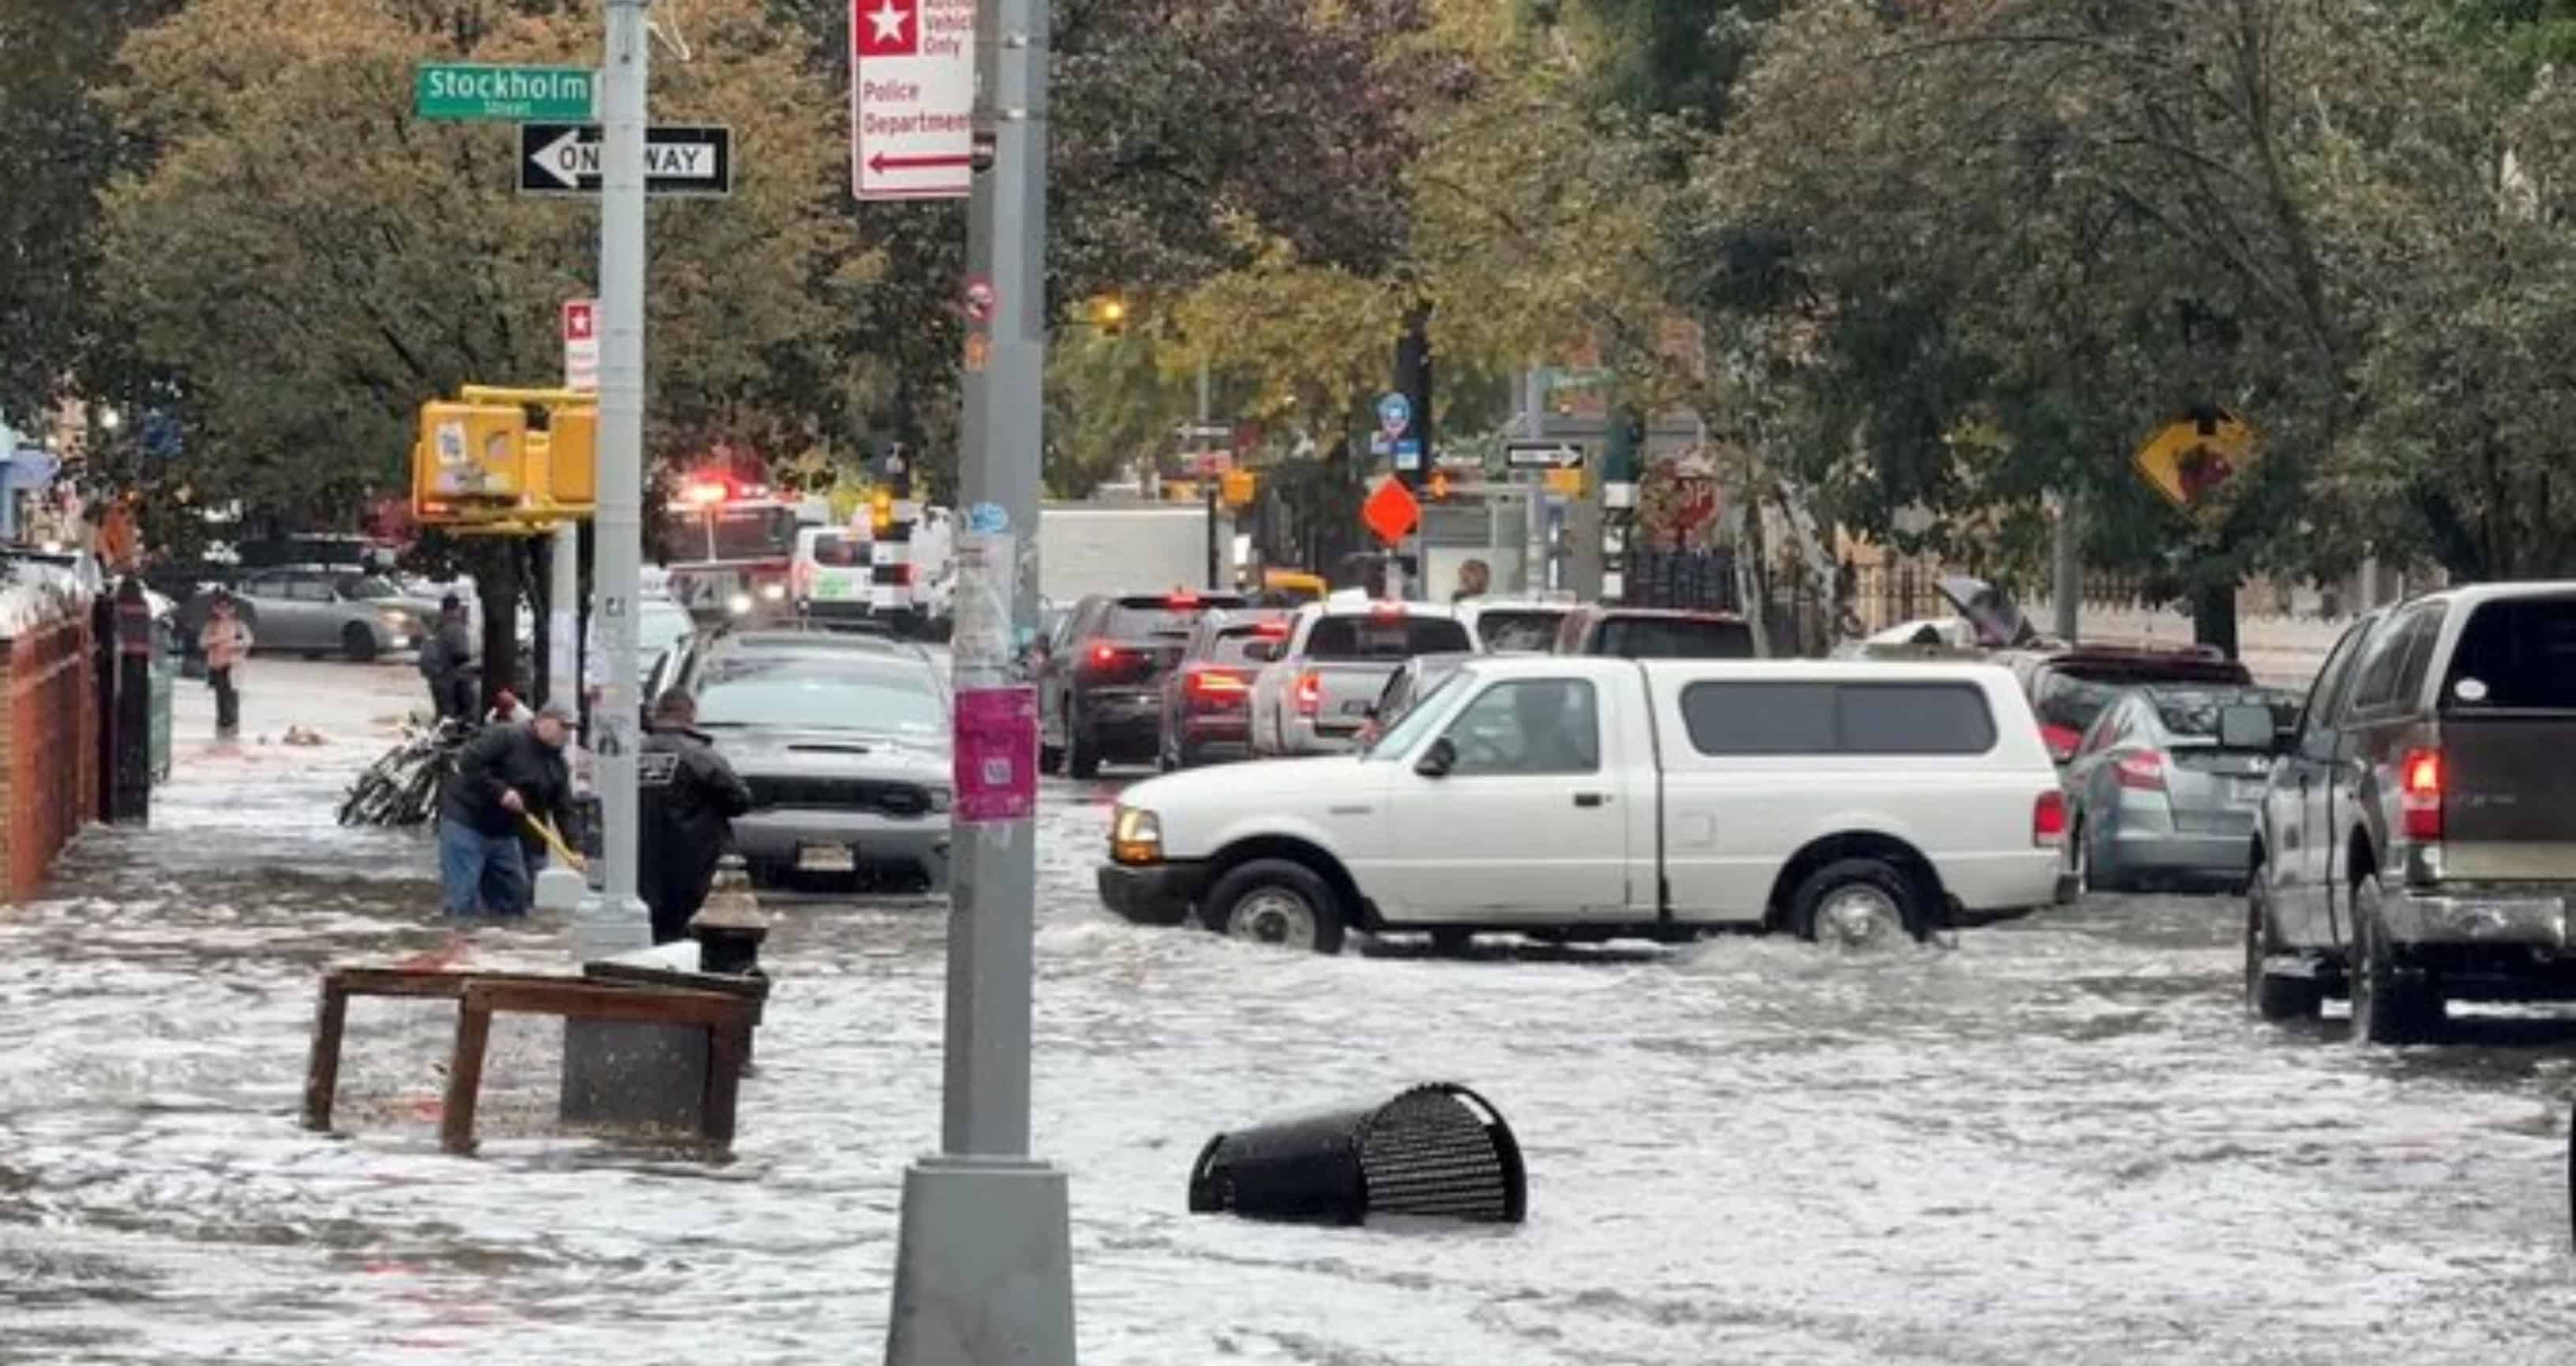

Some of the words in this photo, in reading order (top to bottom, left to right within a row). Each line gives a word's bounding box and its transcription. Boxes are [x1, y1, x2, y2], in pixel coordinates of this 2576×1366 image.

[924, 37, 960, 59] Only
[429, 69, 588, 99] Stockholm
[864, 79, 919, 101] Police
[560, 146, 600, 171] ON
[643, 146, 698, 171] WAY
